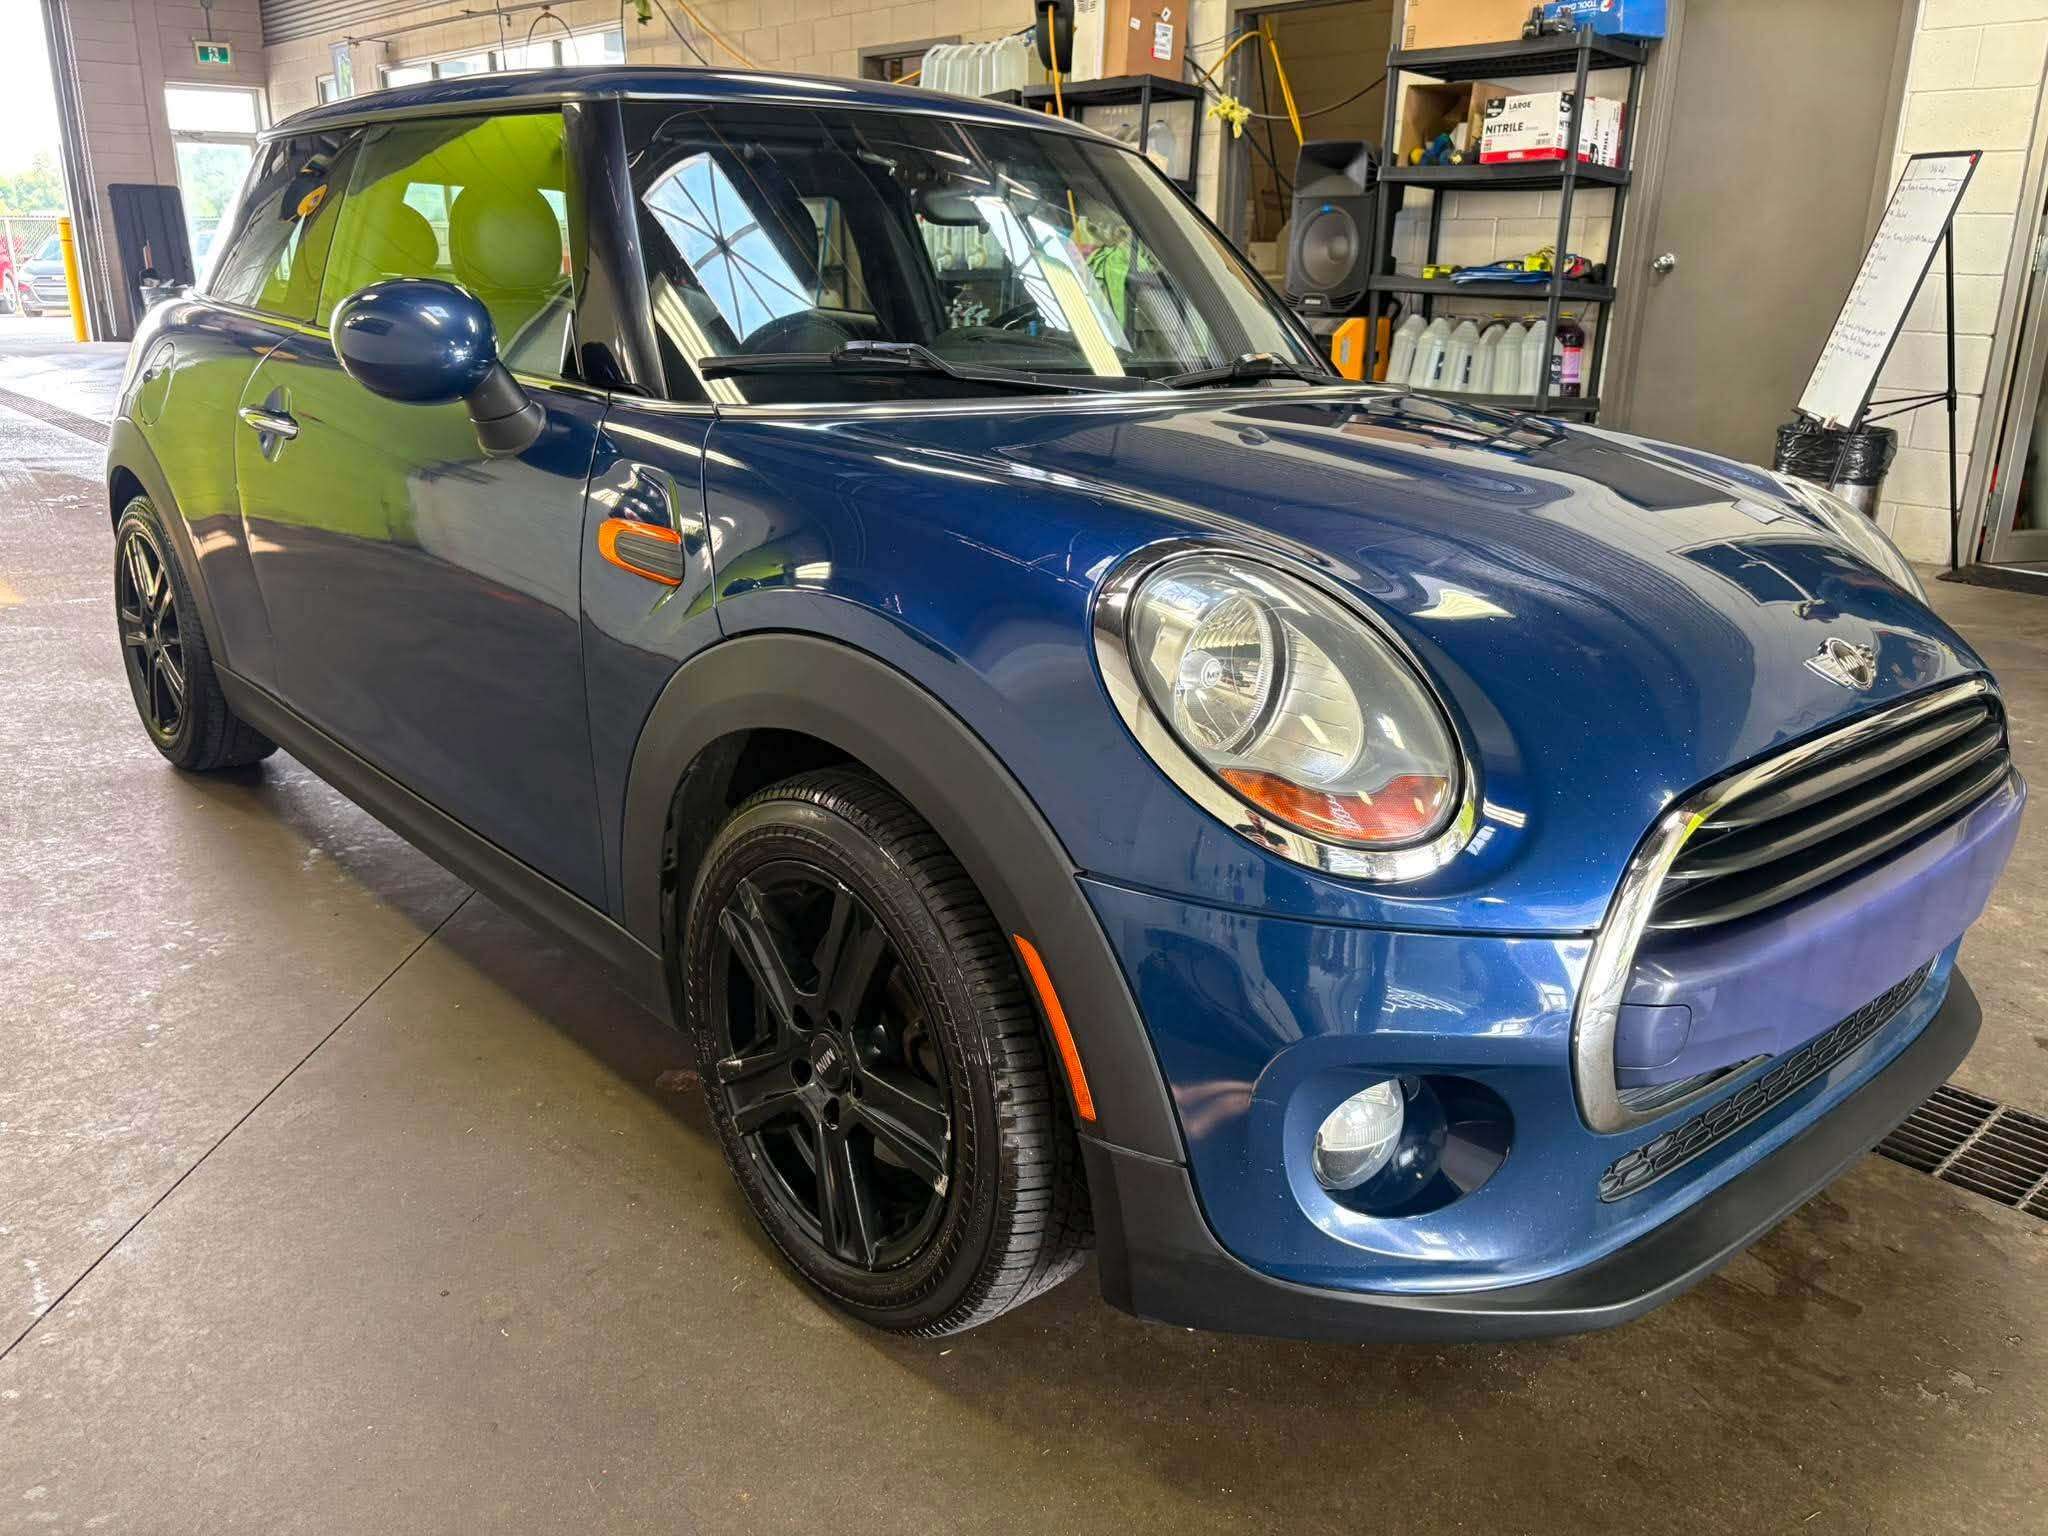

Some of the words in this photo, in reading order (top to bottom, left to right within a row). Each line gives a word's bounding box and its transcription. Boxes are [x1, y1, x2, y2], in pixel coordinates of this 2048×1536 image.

[1508, 101, 1532, 110] LARGE
[1485, 122, 1524, 134] NITRILE
[815, 1048, 836, 1075] MINI
